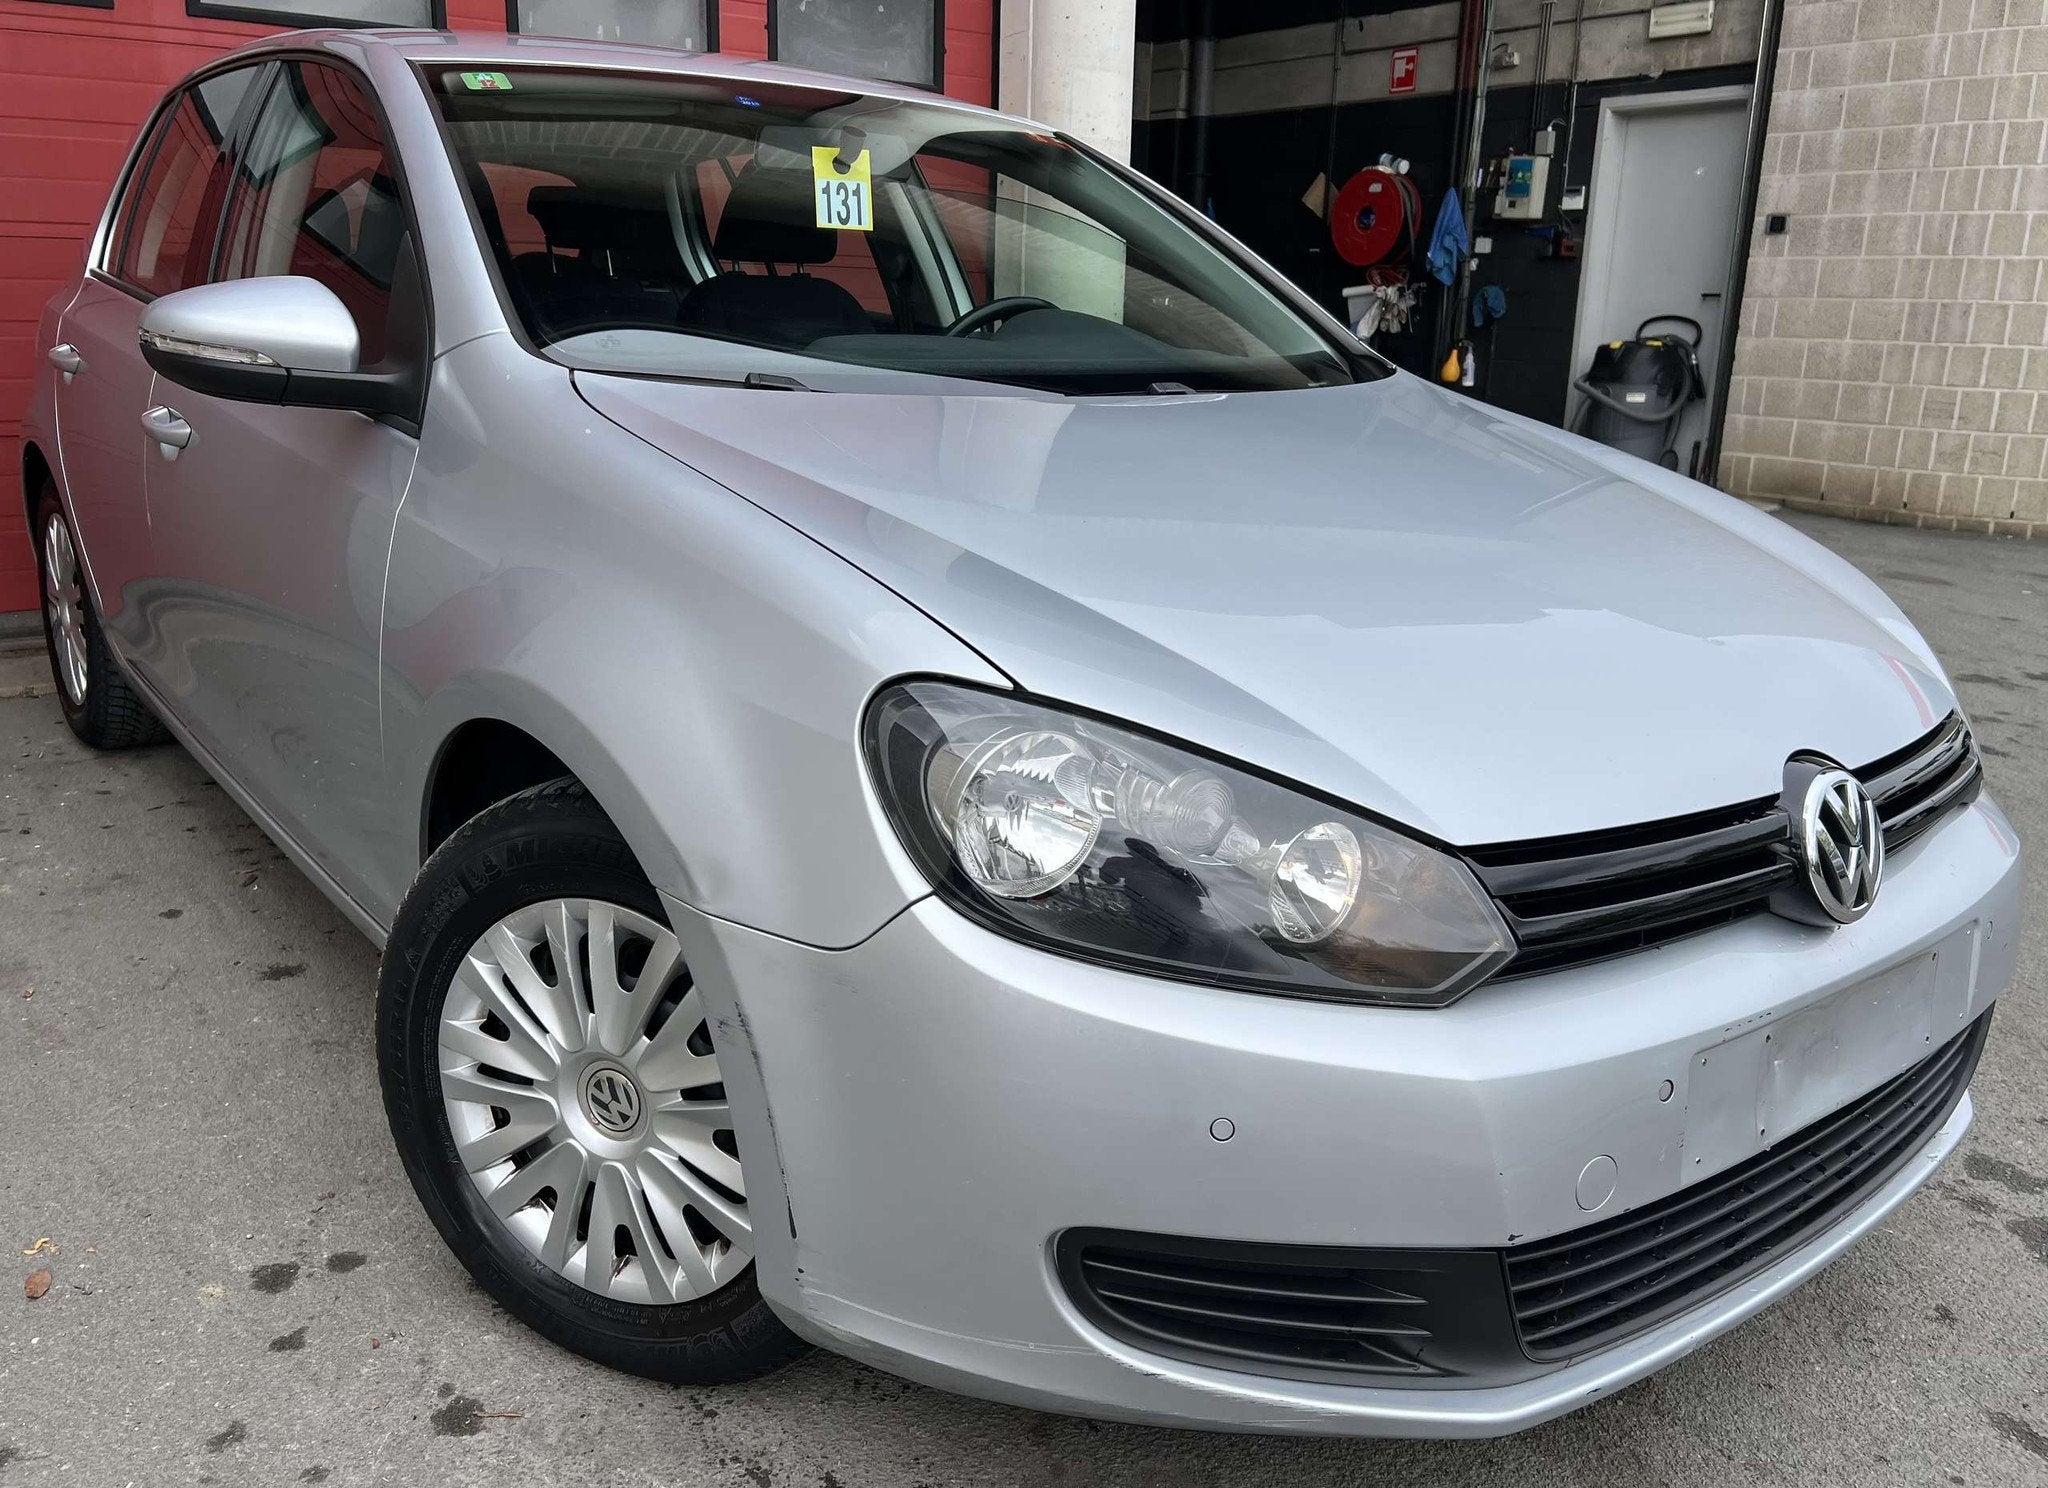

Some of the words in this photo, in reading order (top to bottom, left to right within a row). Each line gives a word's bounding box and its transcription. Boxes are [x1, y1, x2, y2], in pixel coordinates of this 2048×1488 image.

[821, 180, 863, 226] 131
[1810, 775, 1879, 915] VW
[588, 1071, 638, 1130] VW
